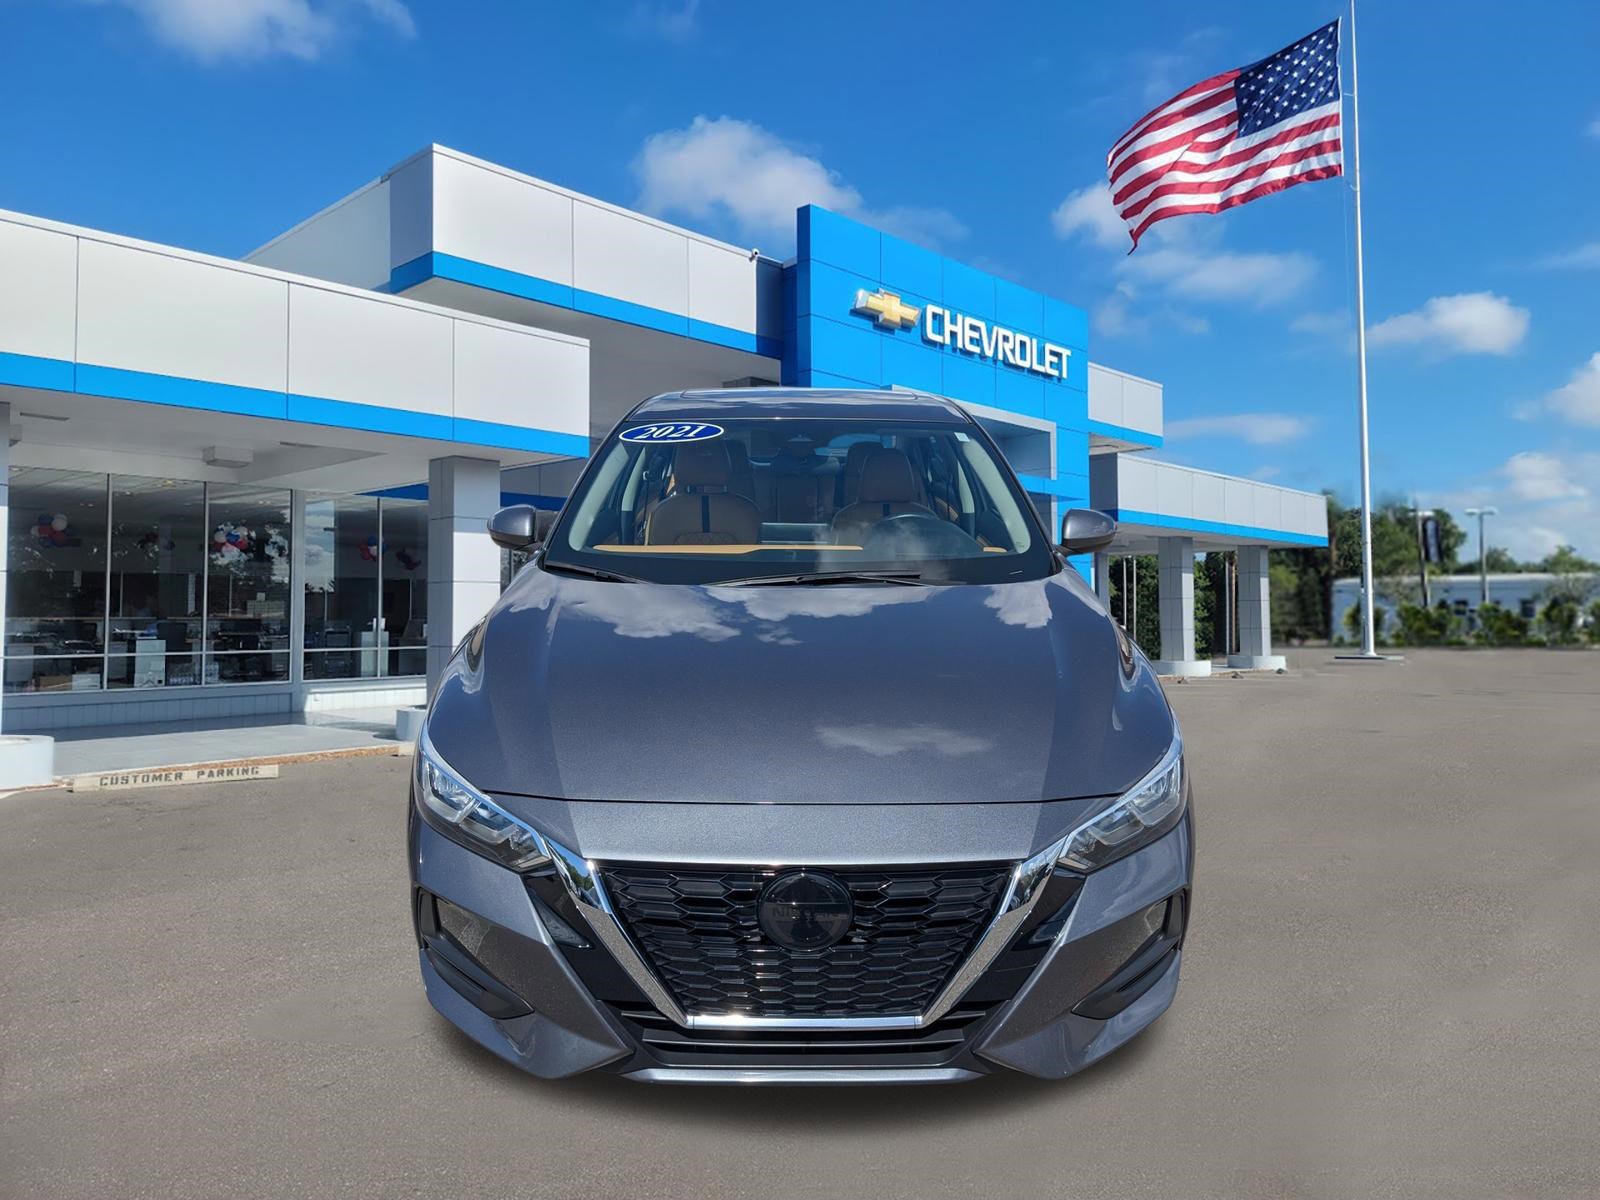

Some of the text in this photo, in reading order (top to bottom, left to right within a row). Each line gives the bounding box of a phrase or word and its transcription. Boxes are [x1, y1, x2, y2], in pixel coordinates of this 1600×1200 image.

[925, 304, 1072, 379] CHEVROLET
[633, 425, 707, 440] 2021
[99, 766, 259, 786] CUSTOMER PARKING
